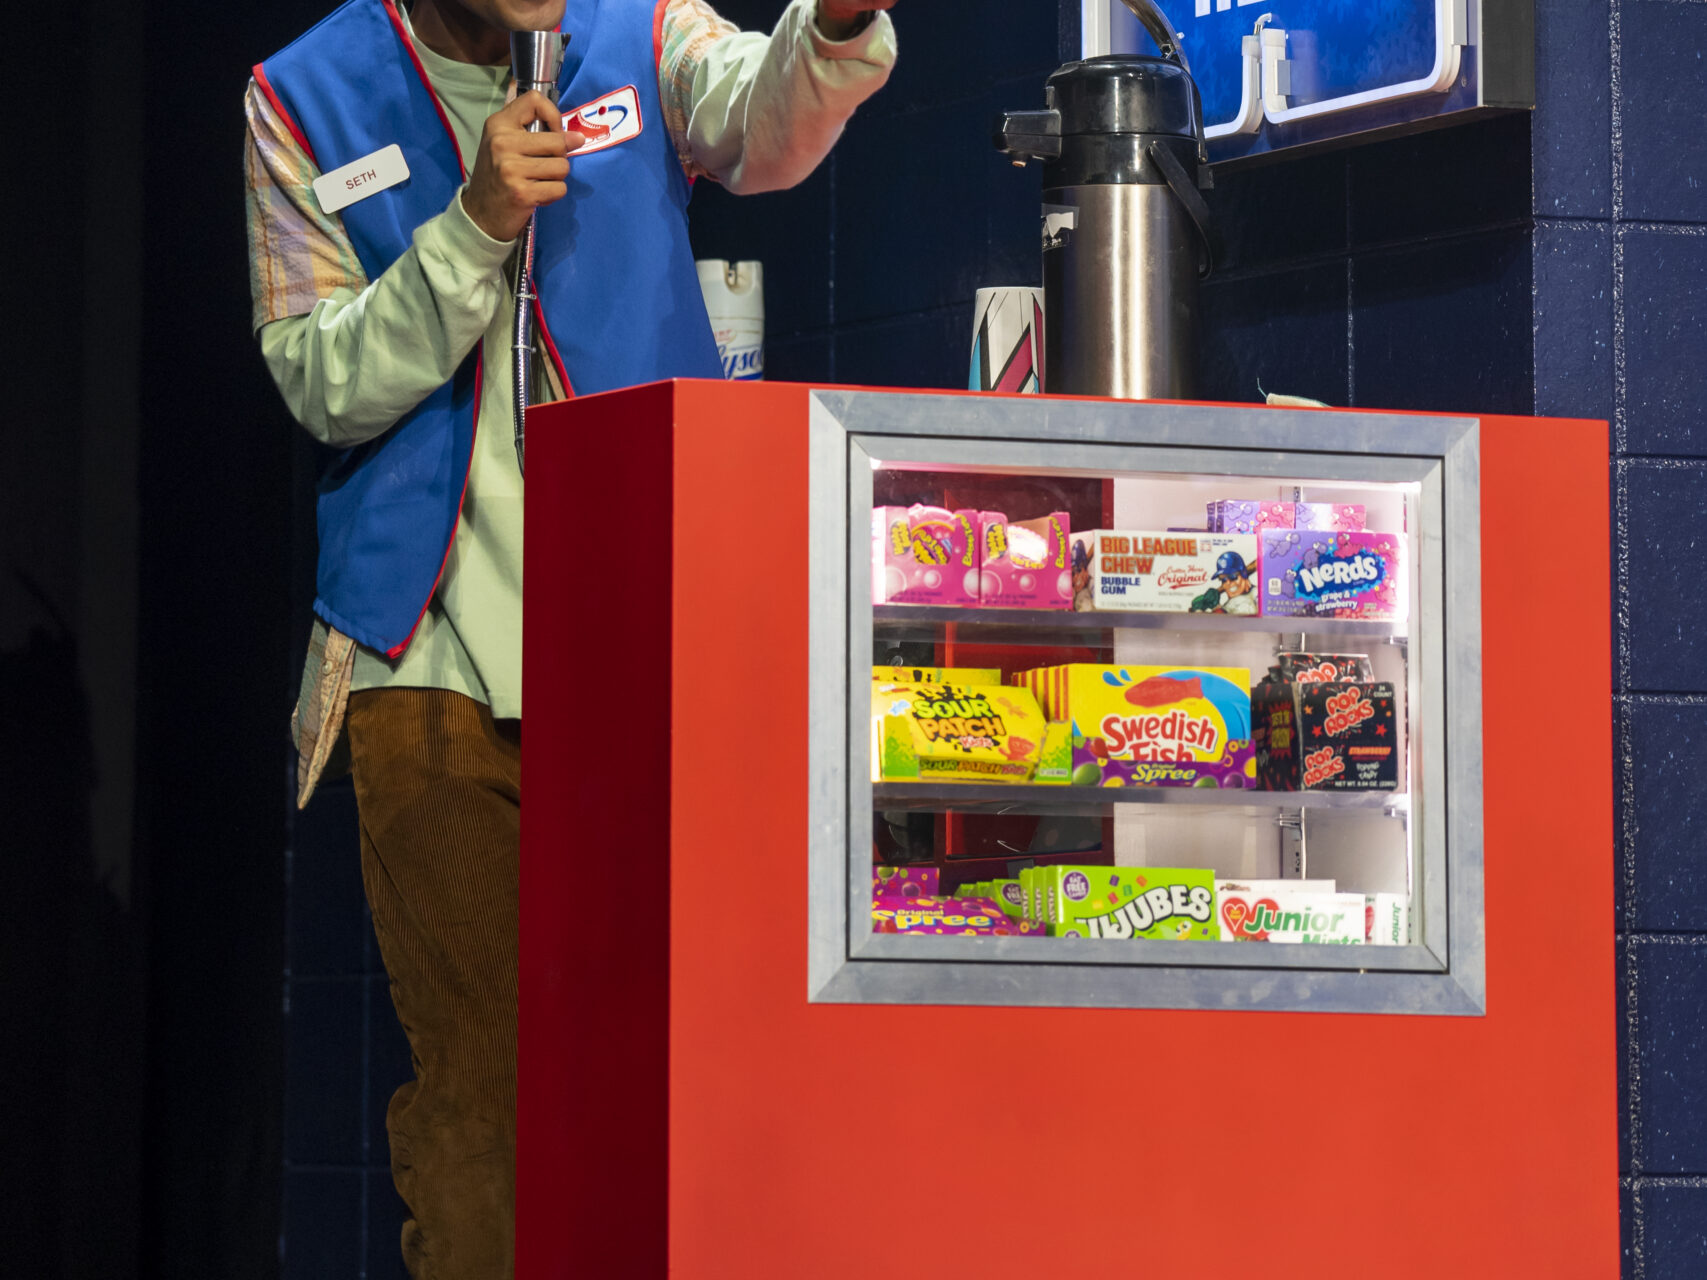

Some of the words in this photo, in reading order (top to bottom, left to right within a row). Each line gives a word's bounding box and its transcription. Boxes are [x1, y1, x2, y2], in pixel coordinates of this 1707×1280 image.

[345, 169, 377, 190] SETH
[1100, 536, 1130, 555] BIG
[1132, 537, 1198, 557] LEAGUE
[1100, 556, 1155, 575] CHEW
[1100, 576, 1141, 587] BUBBLE
[1157, 571, 1208, 588] Original
[1100, 586, 1127, 595] GUM
[1315, 600, 1358, 613] strawberry
[913, 698, 995, 719] SOUR
[1326, 686, 1361, 716] POP
[916, 716, 1007, 741] PATCH
[1324, 699, 1375, 737] ROCKS
[1101, 709, 1217, 754] Swedish
[1130, 740, 1194, 762] Fish
[1305, 746, 1334, 770] POP
[1131, 764, 1197, 782] Spree
[1303, 756, 1345, 787] ROCKS
[871, 910, 991, 930] Spree
[896, 909, 944, 917] Original
[1074, 884, 1212, 939] UJUBES
[1243, 904, 1345, 934] Junior
[1391, 902, 1402, 944] Junior
